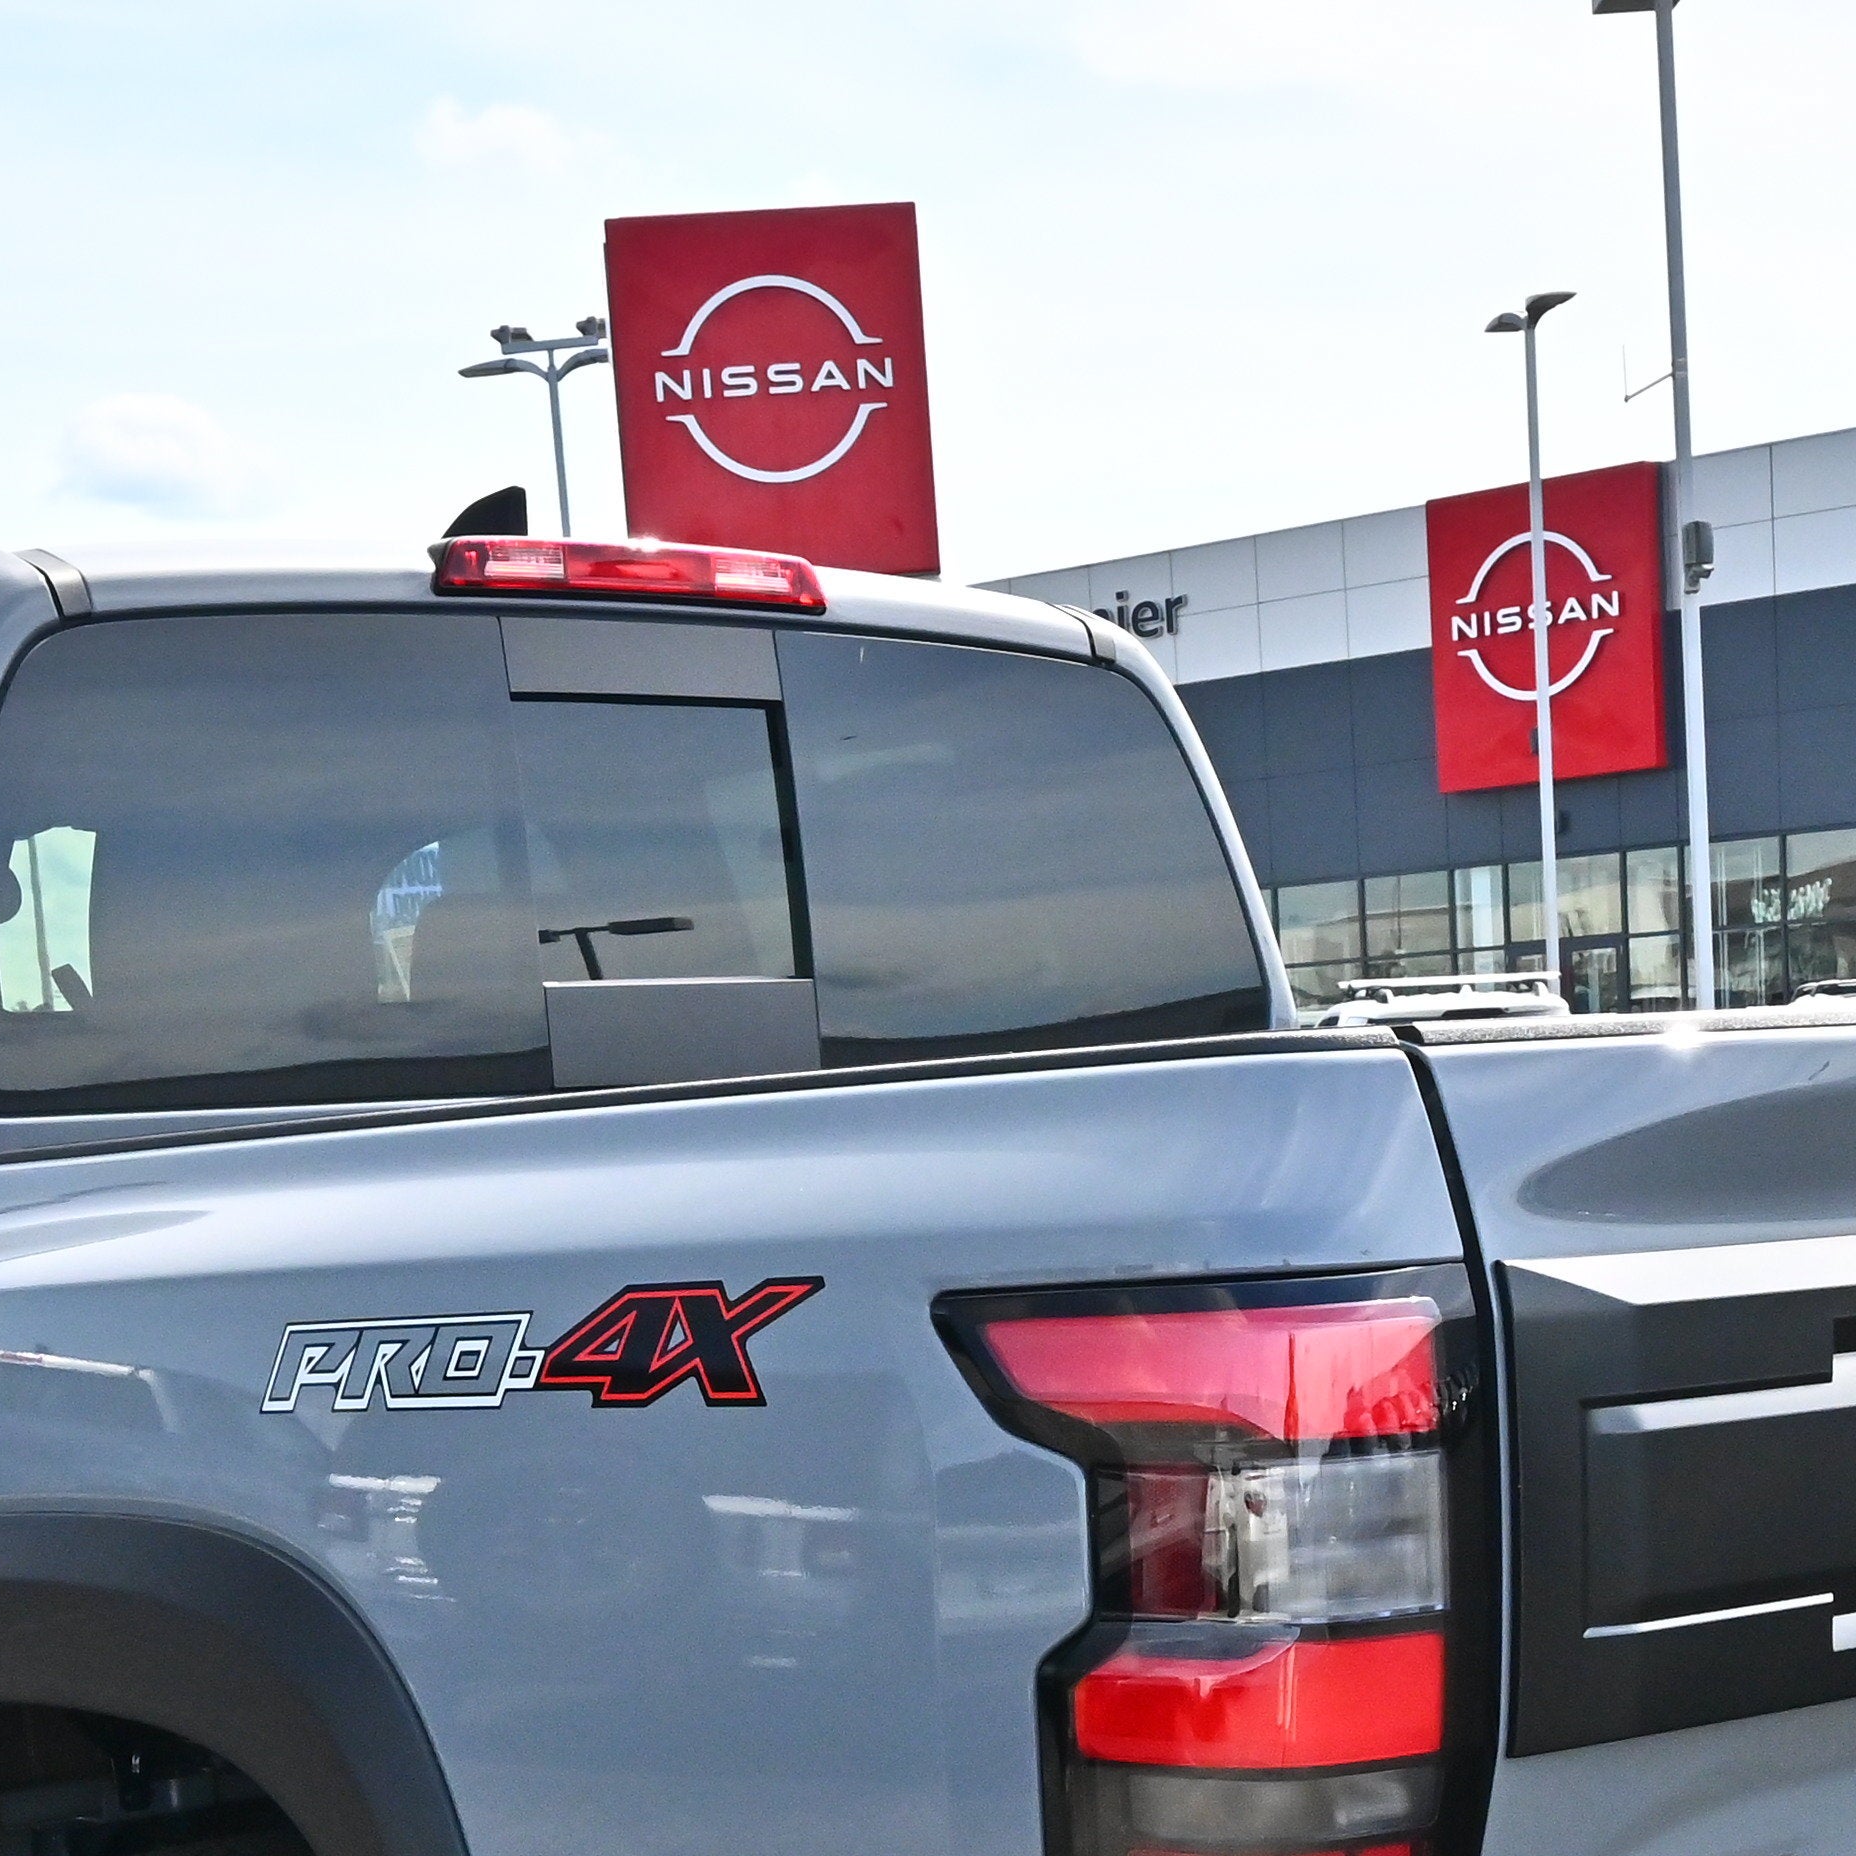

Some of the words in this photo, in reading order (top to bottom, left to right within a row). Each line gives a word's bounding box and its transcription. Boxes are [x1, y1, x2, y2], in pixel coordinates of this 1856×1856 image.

[655, 357, 894, 402] NISSAN
[1093, 590, 1187, 638] ier
[1451, 591, 1619, 641] NISSAN
[259, 1276, 826, 1414] PRO-4X
